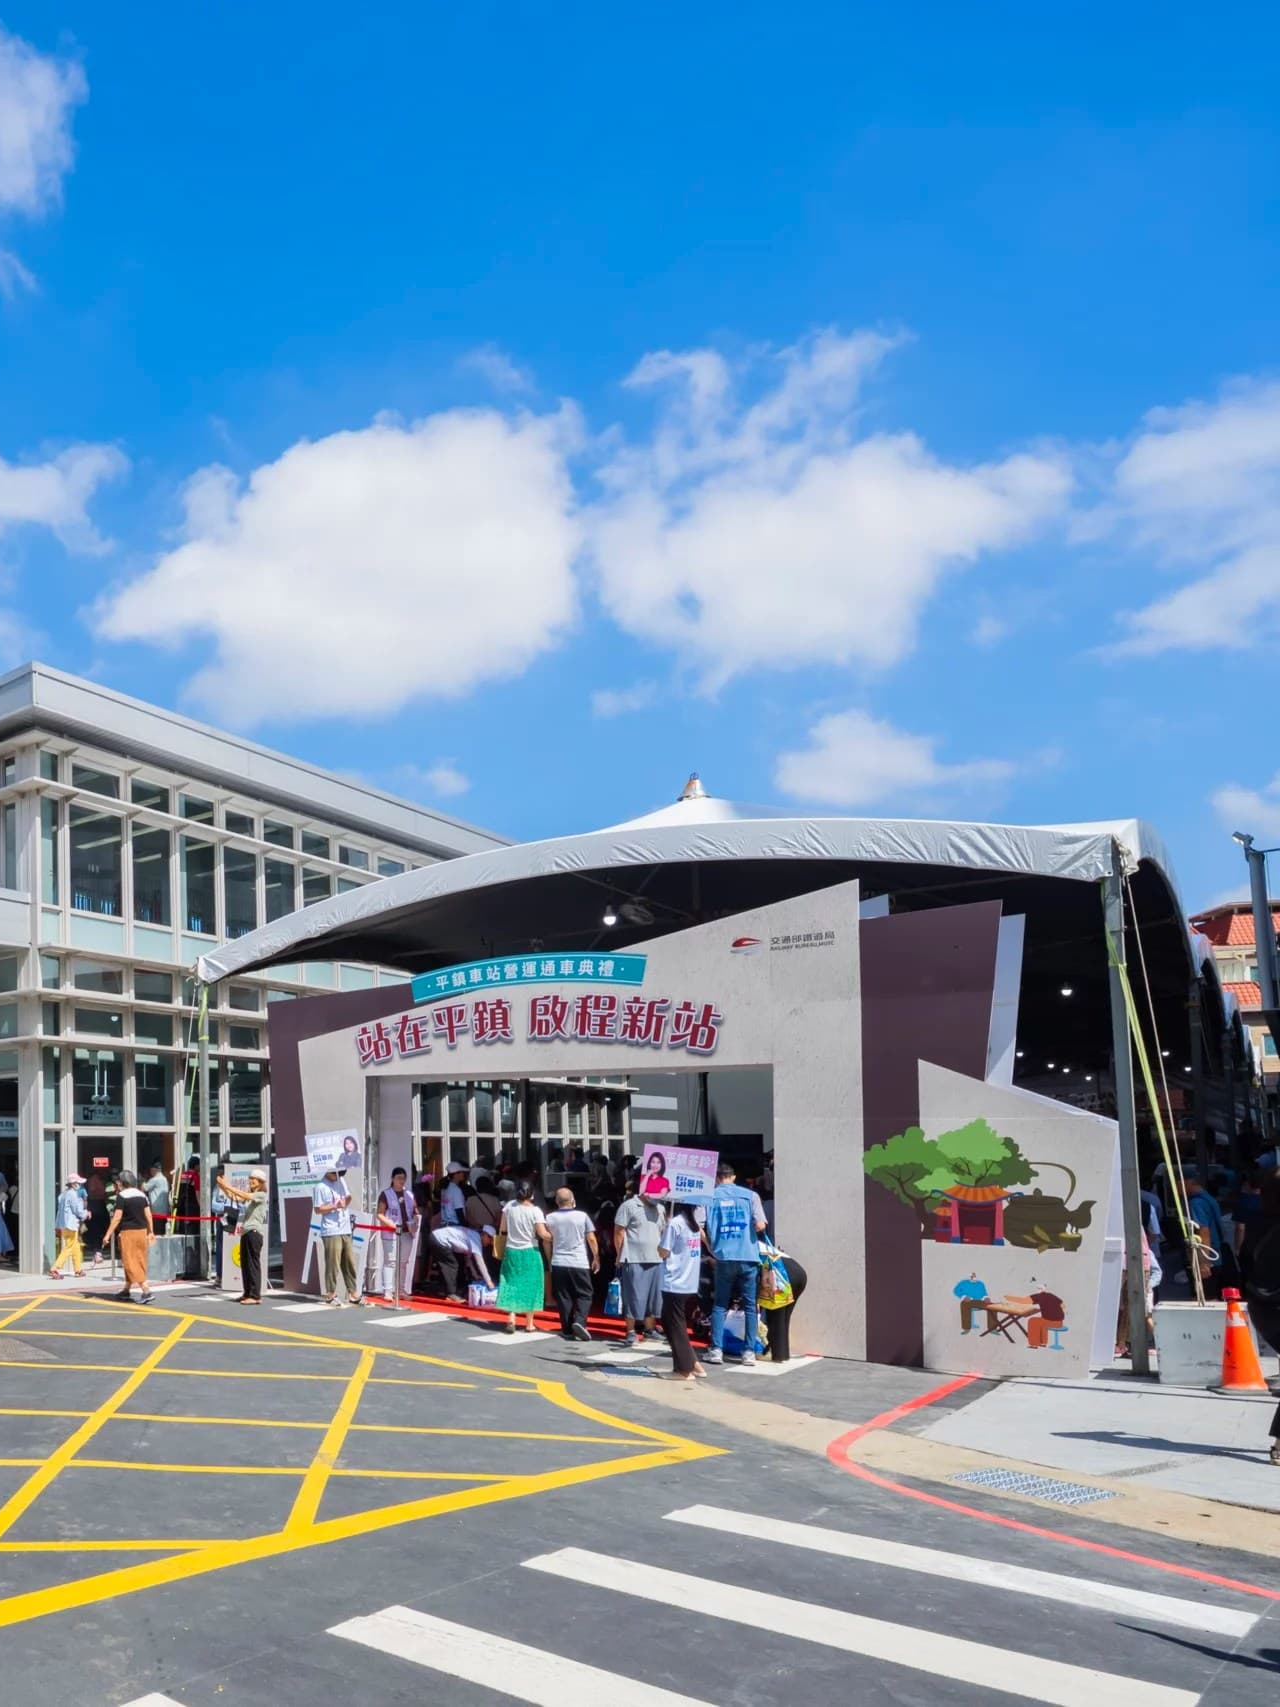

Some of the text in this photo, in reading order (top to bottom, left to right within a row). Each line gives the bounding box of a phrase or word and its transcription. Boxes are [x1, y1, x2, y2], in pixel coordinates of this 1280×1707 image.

[436, 959, 615, 990] 平鎮車站營運通車典禮
[356, 994, 723, 1065] 站在平鎮 啟程新站
